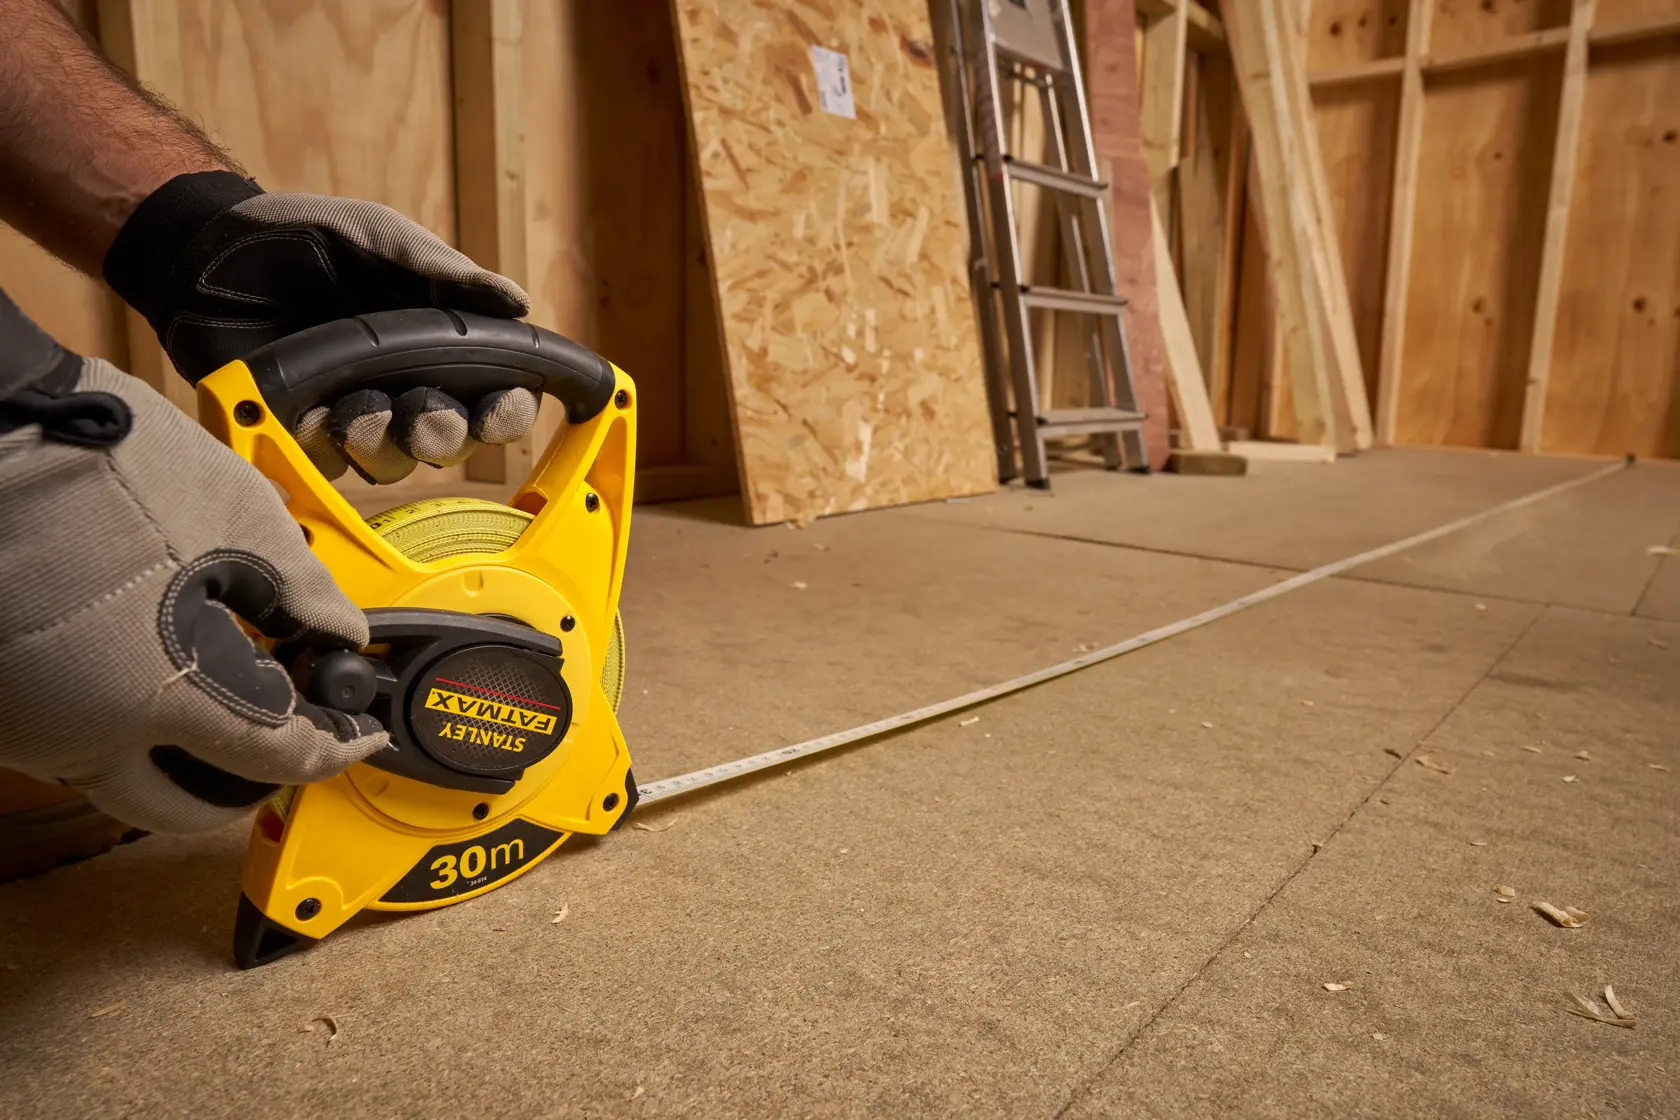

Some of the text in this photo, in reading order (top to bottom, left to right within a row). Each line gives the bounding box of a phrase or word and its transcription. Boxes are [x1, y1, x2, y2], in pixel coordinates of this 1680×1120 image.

[432, 691, 552, 731] FATMAX
[438, 722, 527, 752] STANLEY
[430, 838, 524, 890] 30m
